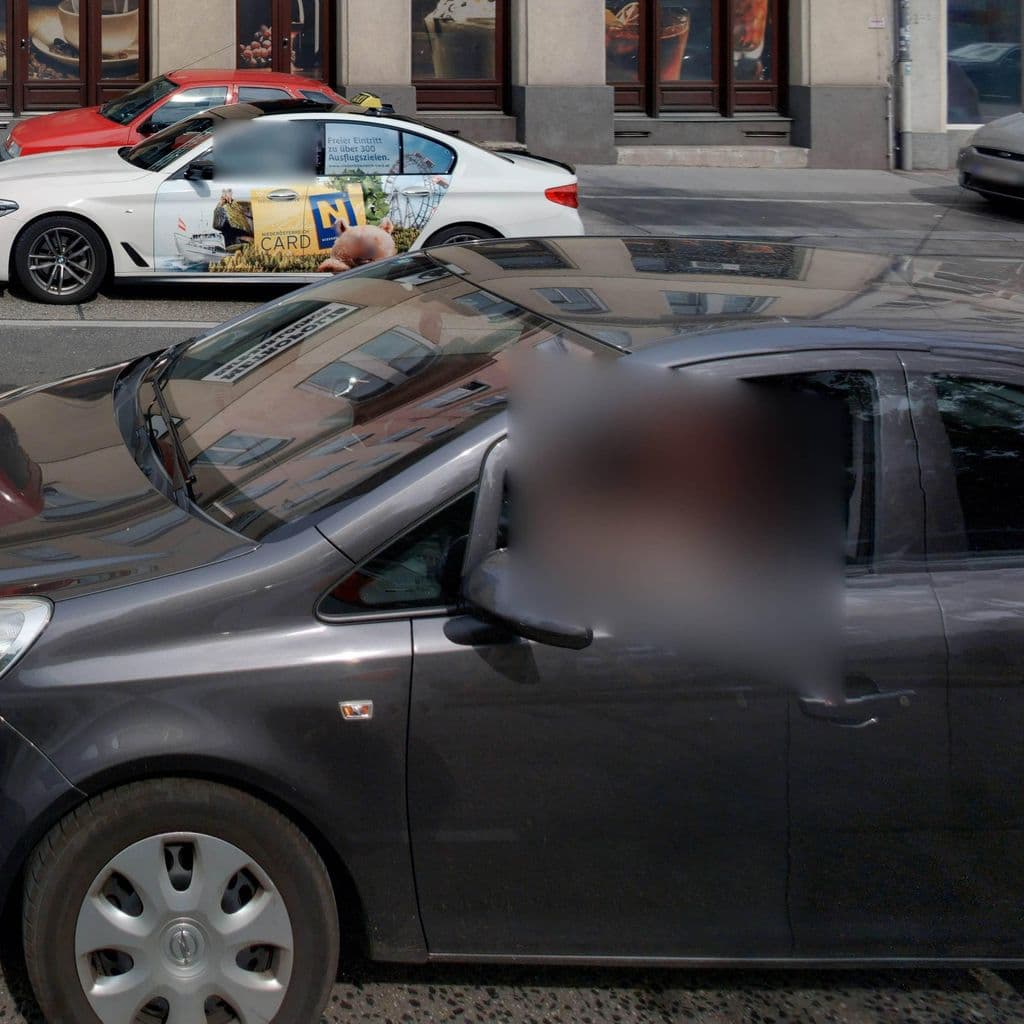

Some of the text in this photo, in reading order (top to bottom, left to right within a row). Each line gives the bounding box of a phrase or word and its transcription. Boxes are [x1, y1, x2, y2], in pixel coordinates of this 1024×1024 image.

[328, 136, 383, 144] Freier Eintritt
[328, 154, 390, 162] Ausflugszielen.
[261, 234, 311, 251] CARD
